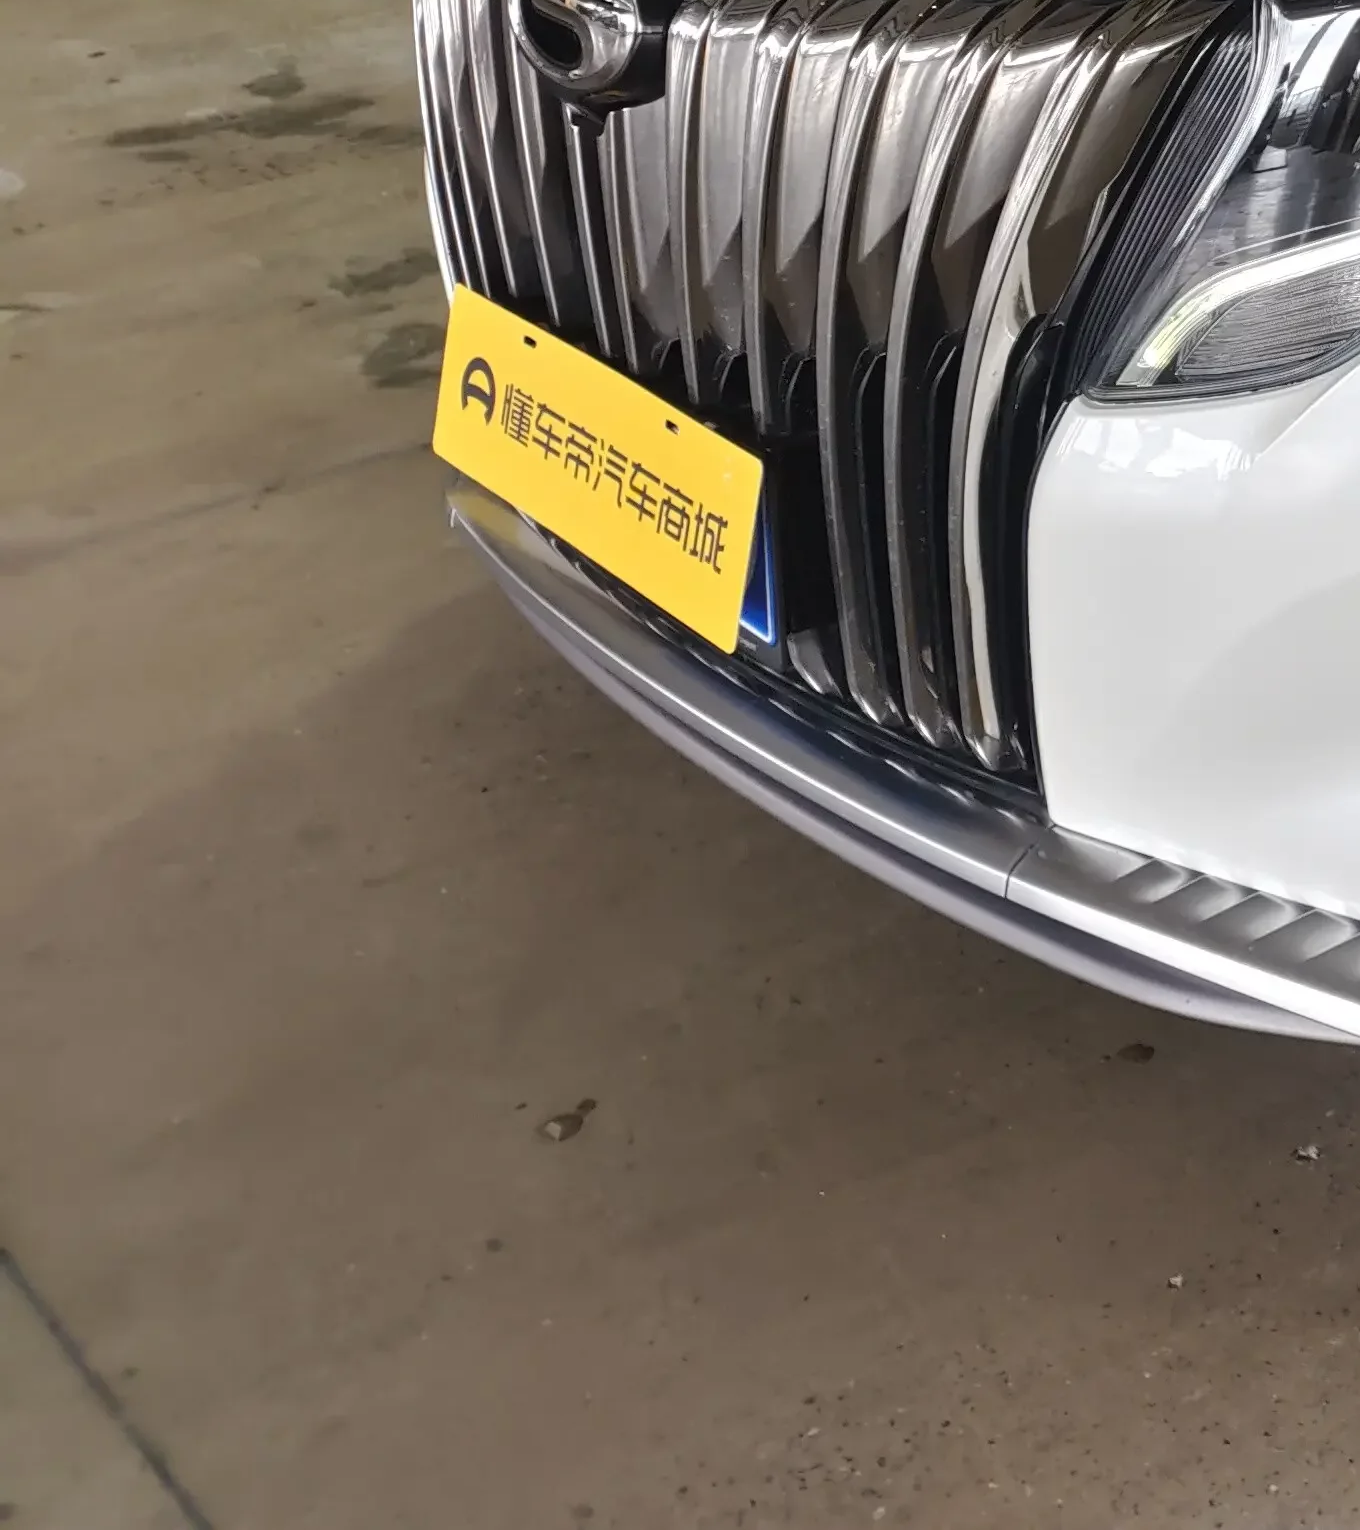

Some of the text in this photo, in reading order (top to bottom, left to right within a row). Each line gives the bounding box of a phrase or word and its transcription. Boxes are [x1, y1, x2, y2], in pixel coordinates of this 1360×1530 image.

[500, 382, 729, 575] 懂车帝汽车商城
